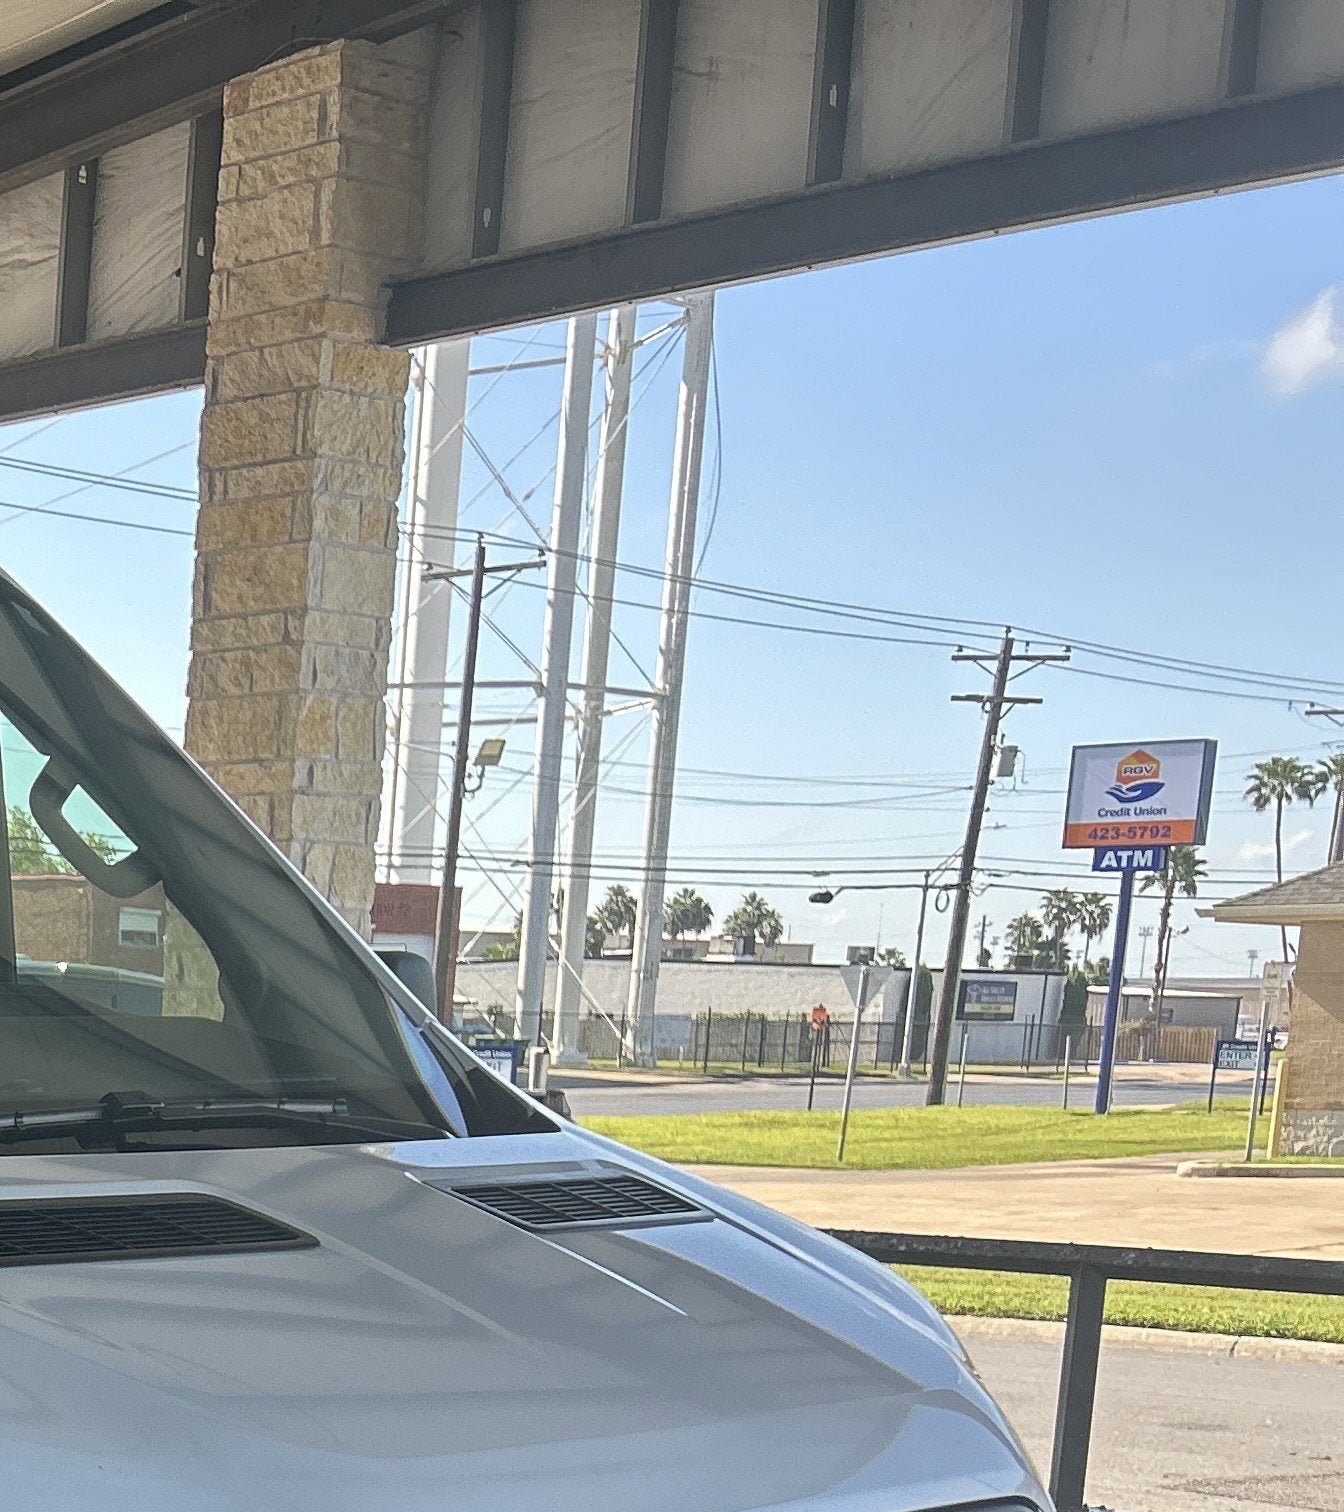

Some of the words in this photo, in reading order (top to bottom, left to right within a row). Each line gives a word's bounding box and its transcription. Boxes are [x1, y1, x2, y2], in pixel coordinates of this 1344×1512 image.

[1122, 763, 1154, 775] RGV
[1097, 807, 1131, 818] Credit
[1133, 805, 1167, 816] Union
[1087, 825, 1172, 841] 423-5792
[1099, 849, 1153, 868] ATM
